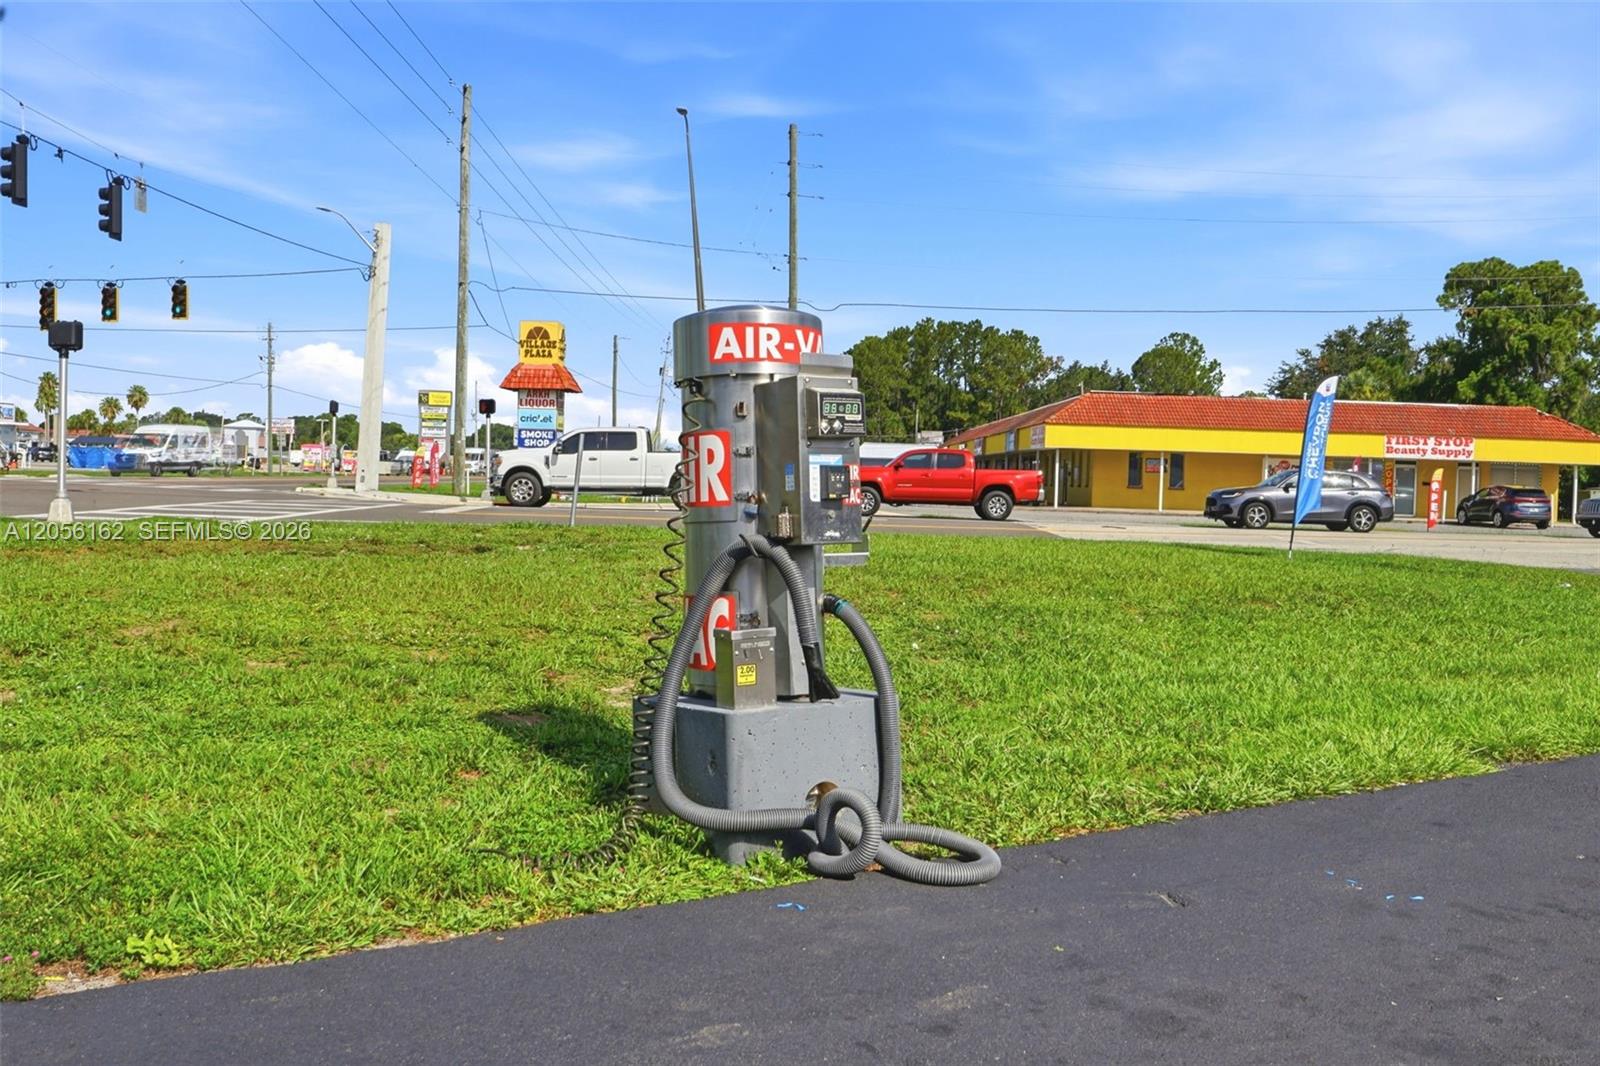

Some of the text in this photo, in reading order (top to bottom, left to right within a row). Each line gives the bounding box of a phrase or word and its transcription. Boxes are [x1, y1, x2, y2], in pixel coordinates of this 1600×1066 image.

[519, 339, 558, 349] VILLAGE
[524, 349, 553, 358] PLAZA
[519, 399, 556, 408] LIQUOR
[520, 430, 554, 438] SMOKE
[524, 438, 550, 447] SHOP
[1386, 434, 1474, 447] FIRST STOP
[1386, 446, 1474, 458] Beauty Supply
[682, 434, 729, 503] IR
[1430, 481, 1441, 520] OPEN
